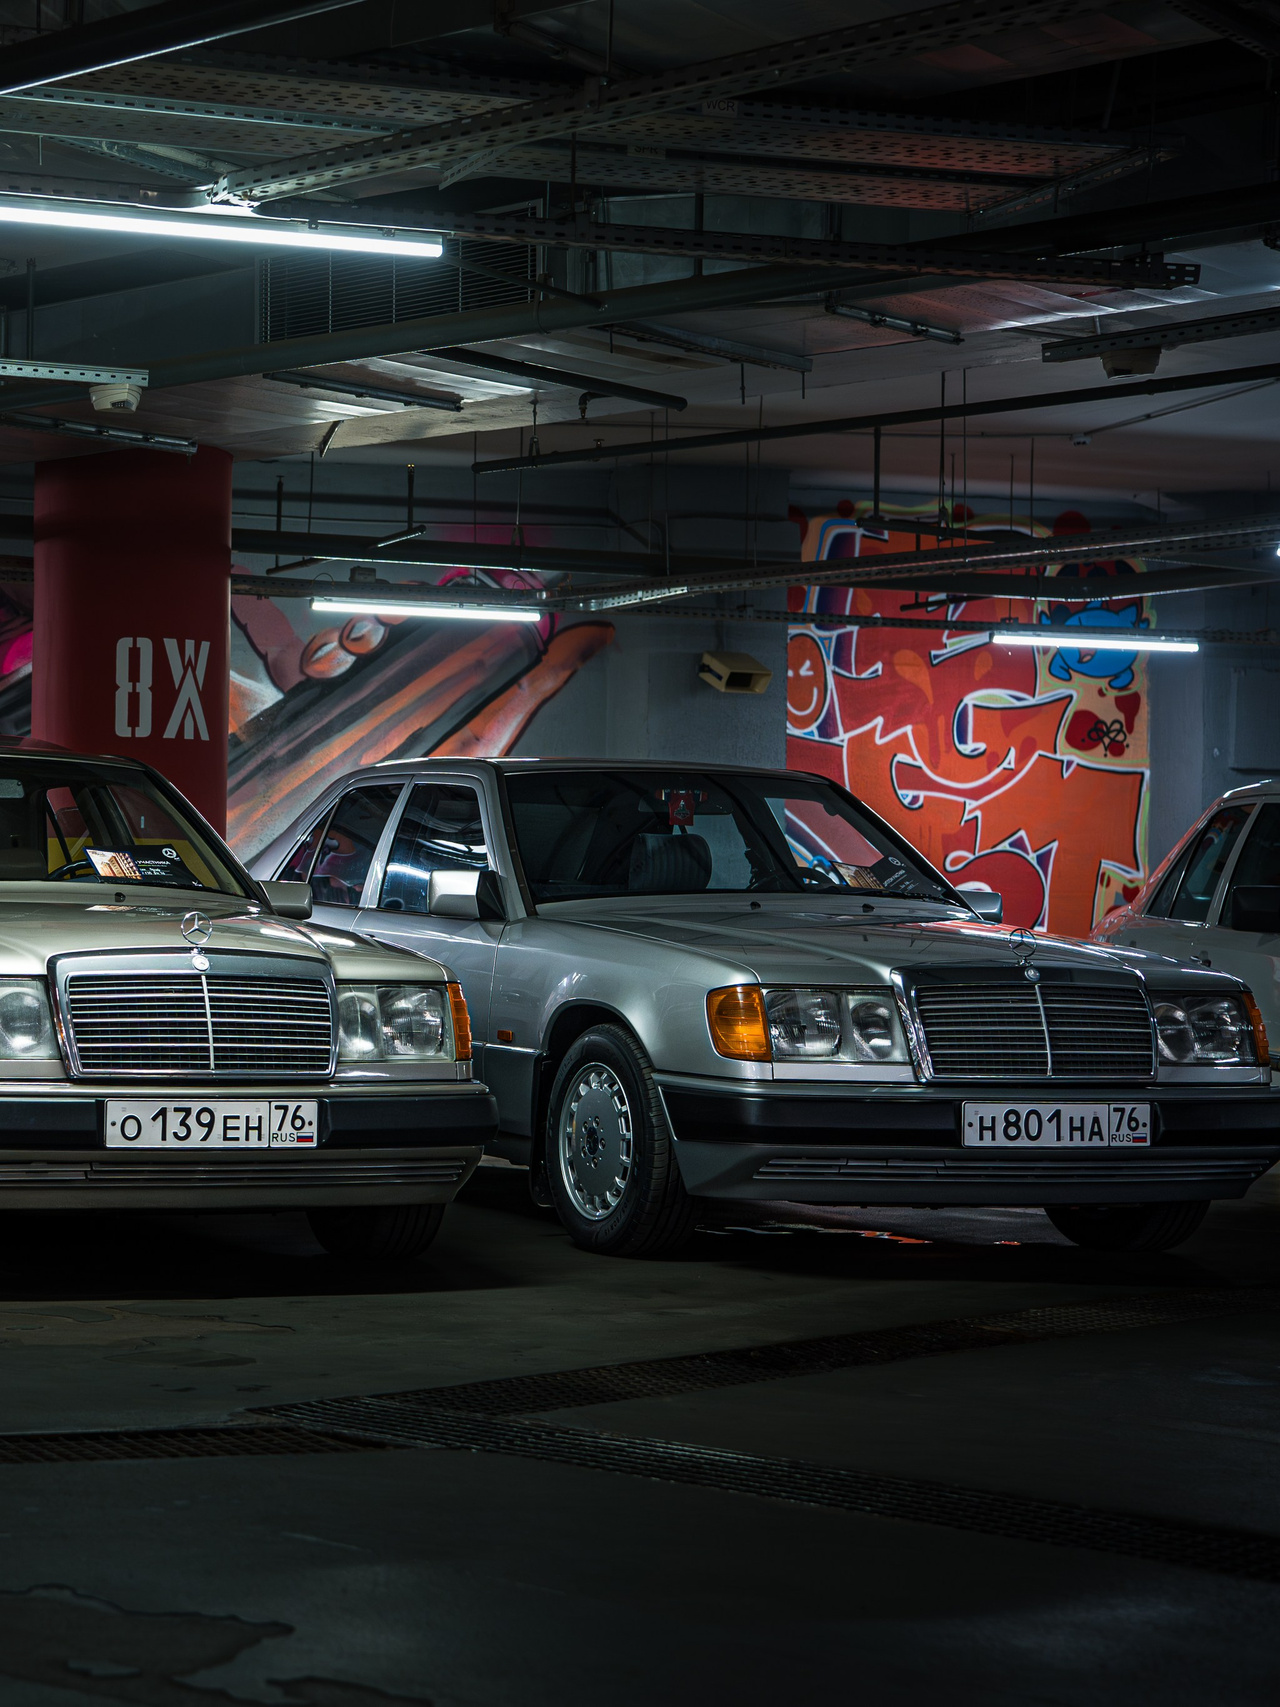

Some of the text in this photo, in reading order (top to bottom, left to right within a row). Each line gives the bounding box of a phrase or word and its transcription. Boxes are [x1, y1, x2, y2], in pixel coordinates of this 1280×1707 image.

[707, 99, 735, 112] WCR
[274, 1105, 305, 1131] 76
[1112, 1107, 1140, 1132] 76
[271, 1132, 296, 1143] RUS
[1111, 1134, 1132, 1143] RUS
